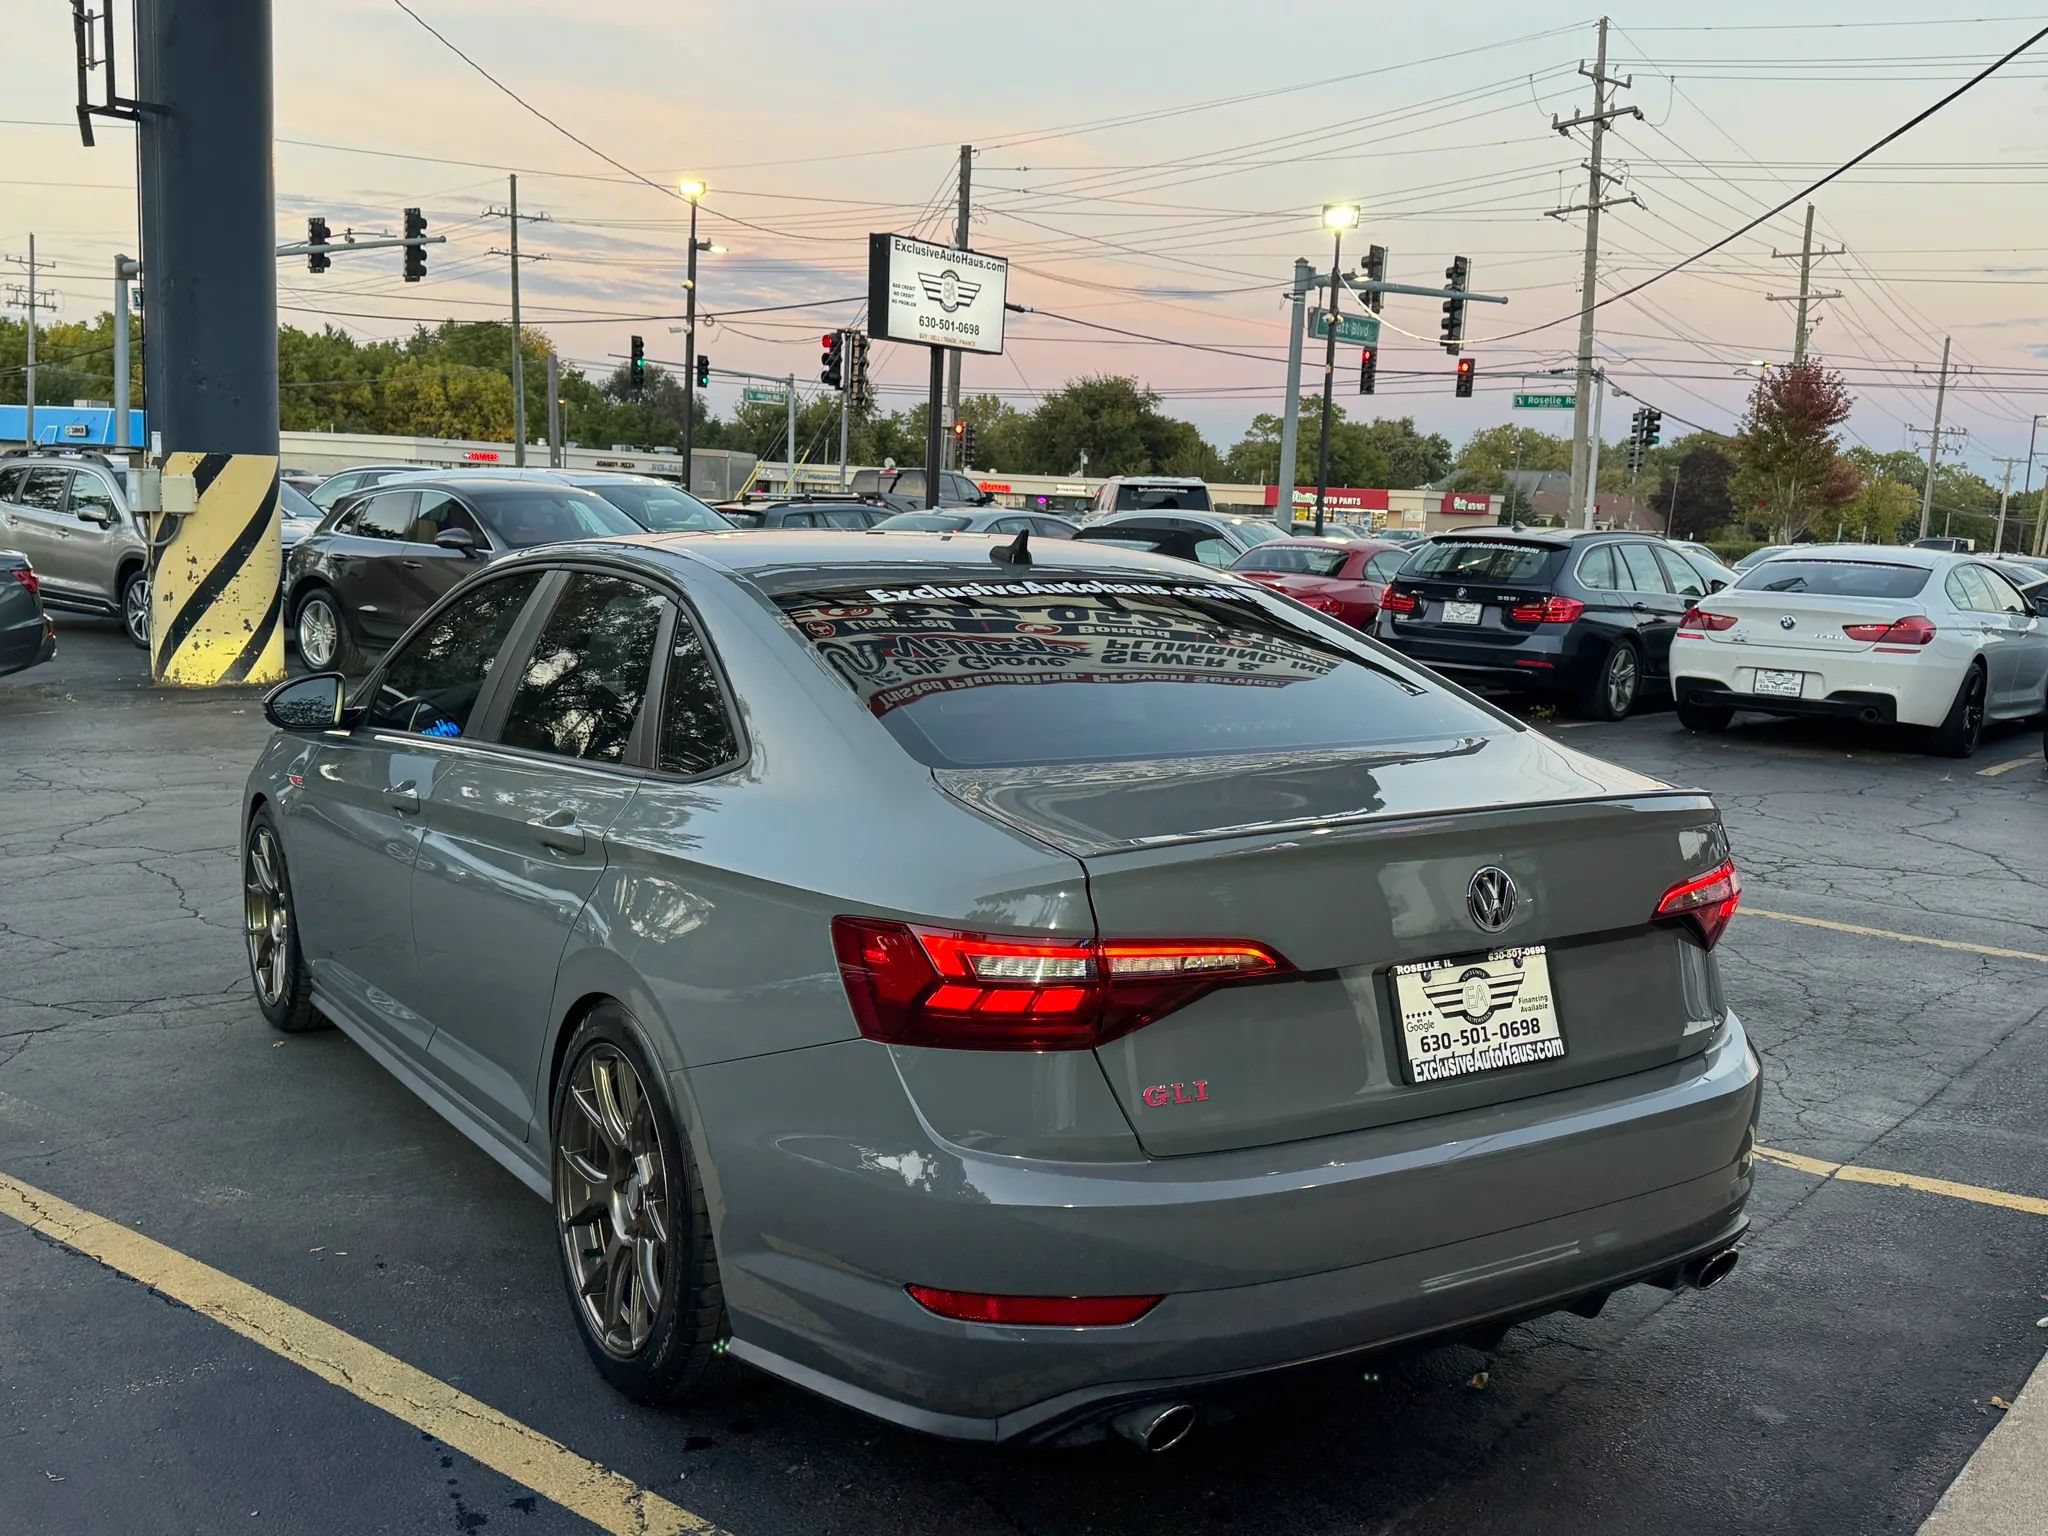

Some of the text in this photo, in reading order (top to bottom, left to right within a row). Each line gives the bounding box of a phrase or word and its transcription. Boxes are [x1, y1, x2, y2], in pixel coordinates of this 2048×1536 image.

[894, 239, 1005, 273] ExclusiveAutoHaus.com
[919, 315, 980, 336] 630-501-0698
[1336, 322, 1370, 337] att Blvd
[1528, 396, 1562, 405] Roselle
[1324, 496, 1337, 504] UTO
[1339, 497, 1361, 506] PARTS
[866, 580, 1241, 603] ExclusiveAutohaus.com
[1488, 945, 1546, 961] 630-501-0698
[1443, 959, 1454, 968] IL
[1518, 994, 1549, 1005] Financing
[1520, 1003, 1548, 1013] Available
[1406, 1019, 1435, 1032] Google
[1420, 1018, 1541, 1053] 630-501-0698
[1411, 1037, 1565, 1083] ExclusiveAutoHaus.com
[1143, 1080, 1209, 1107] GLI
